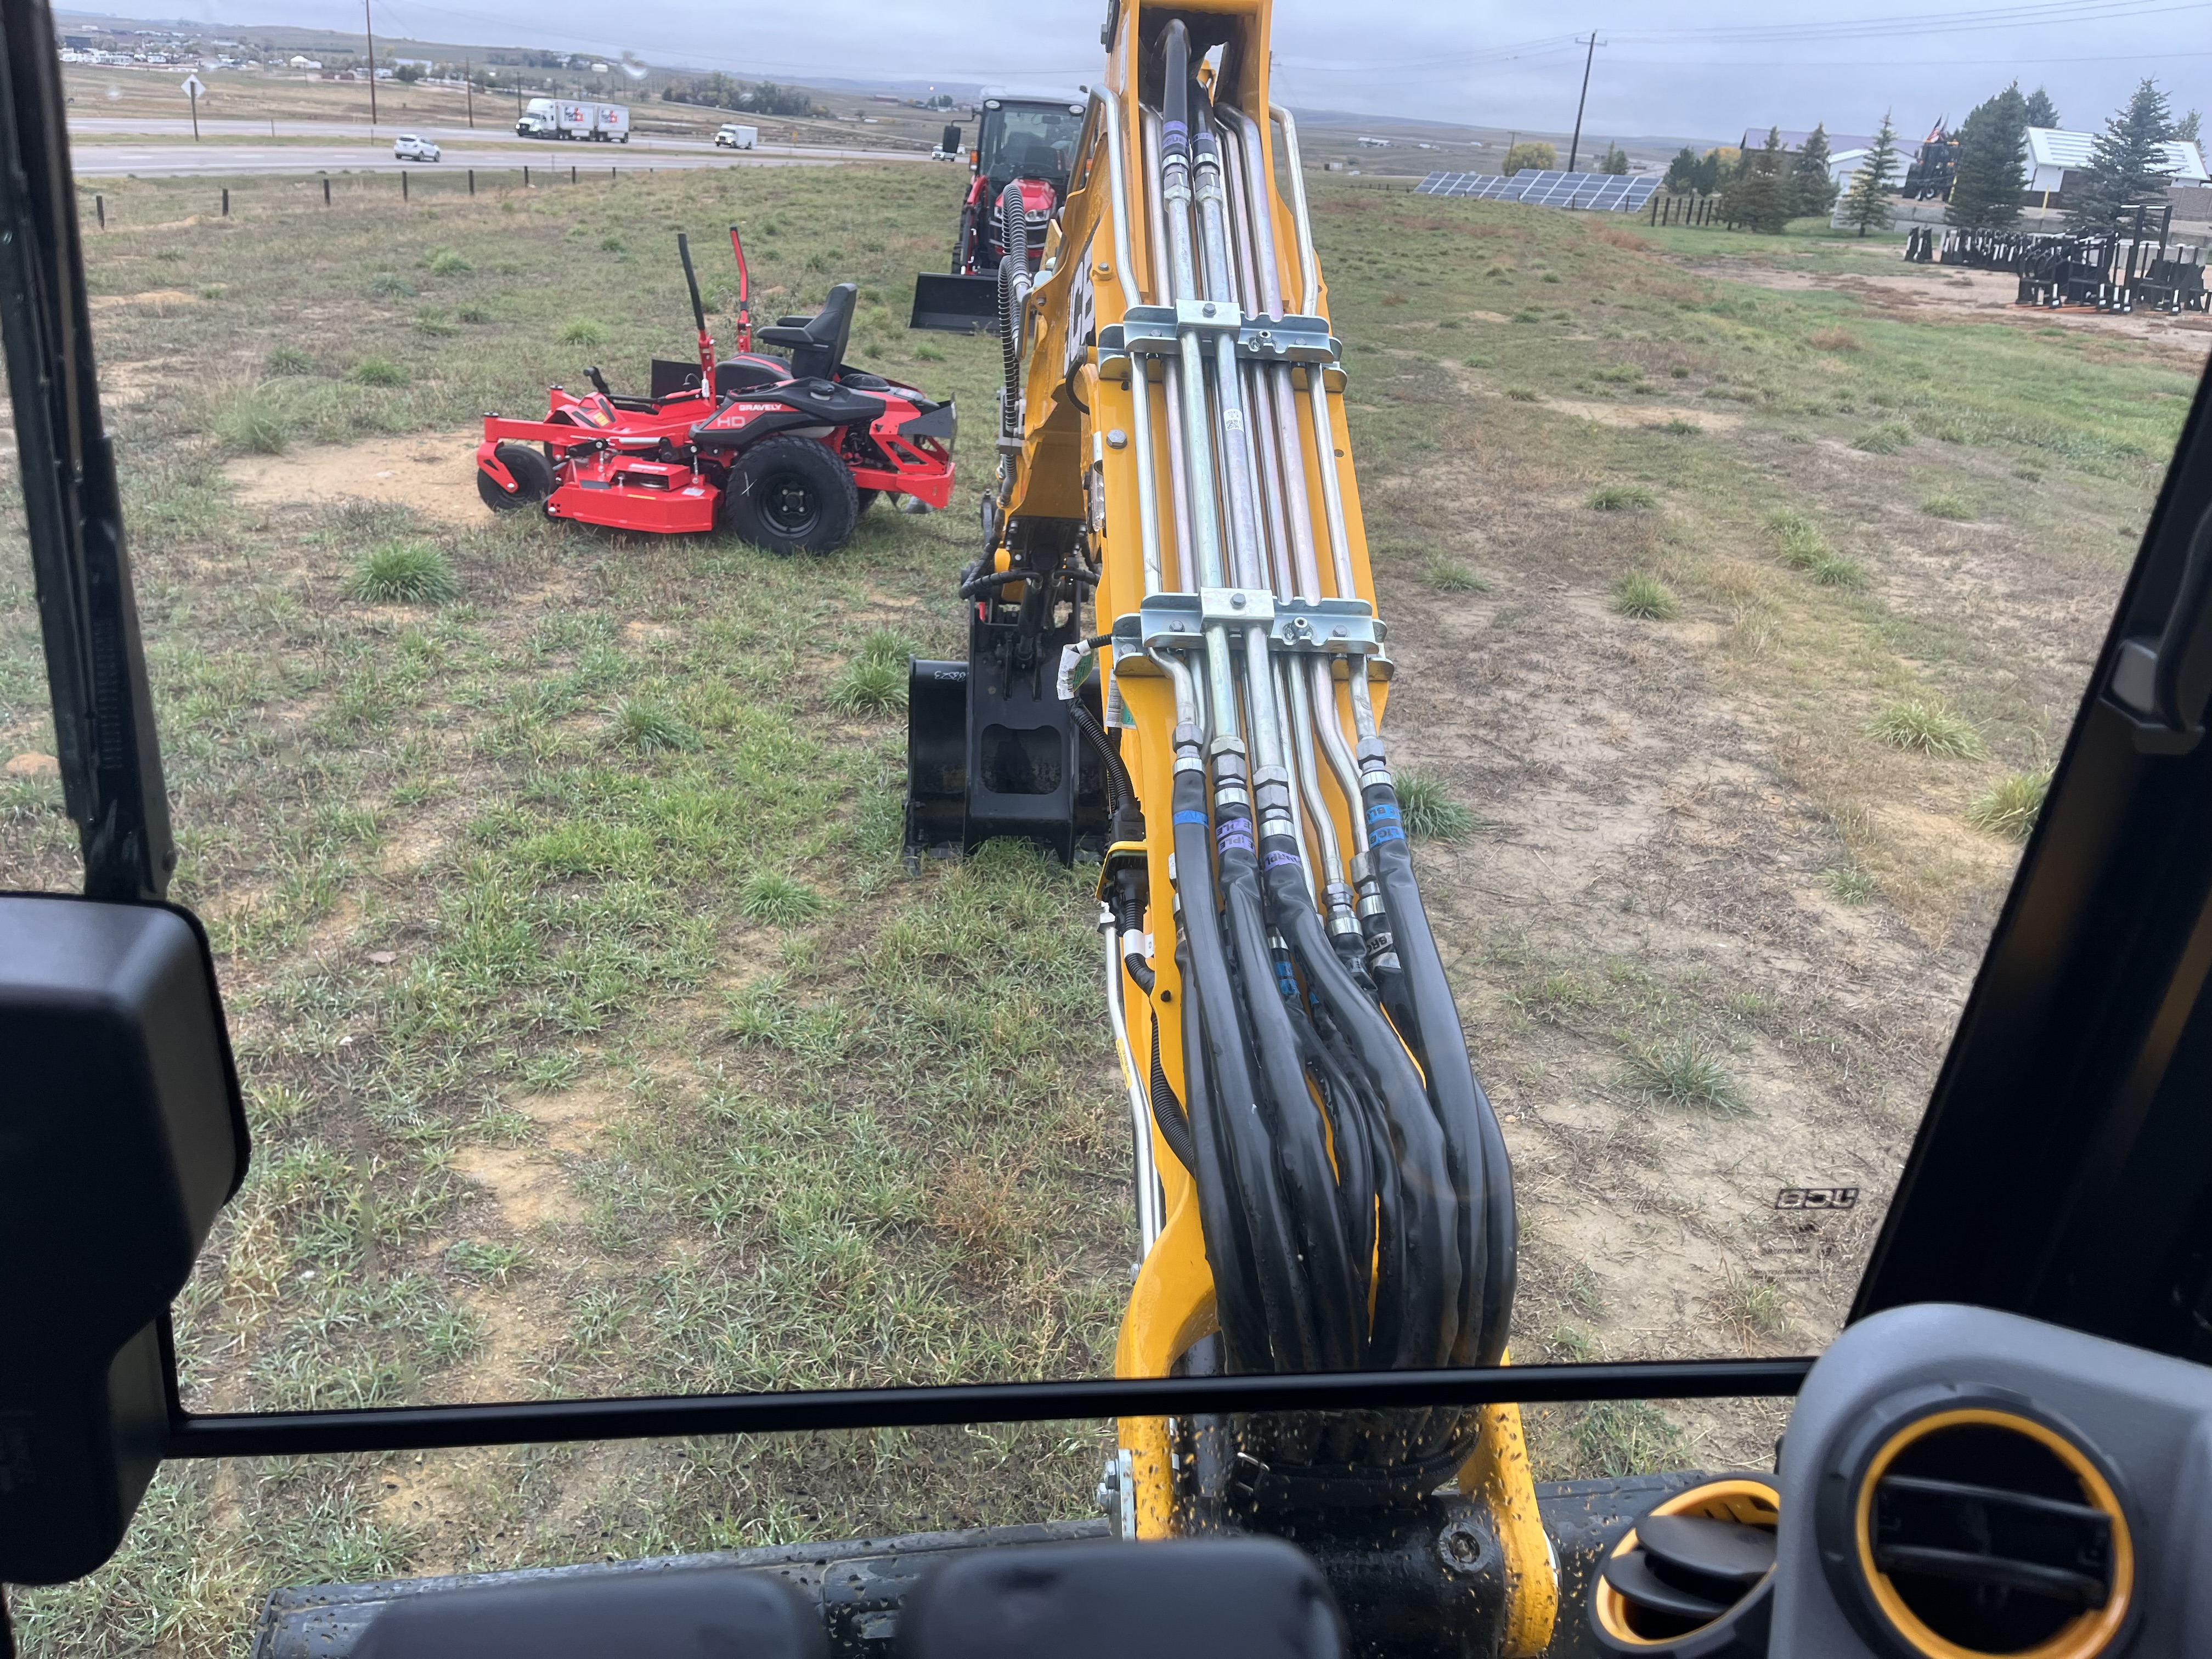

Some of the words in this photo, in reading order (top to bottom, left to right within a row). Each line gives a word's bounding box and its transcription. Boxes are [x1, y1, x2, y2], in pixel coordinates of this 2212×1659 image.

[1064, 240, 1095, 377] JCB
[738, 403, 782, 411] GRAVELY
[717, 415, 746, 427] HD
